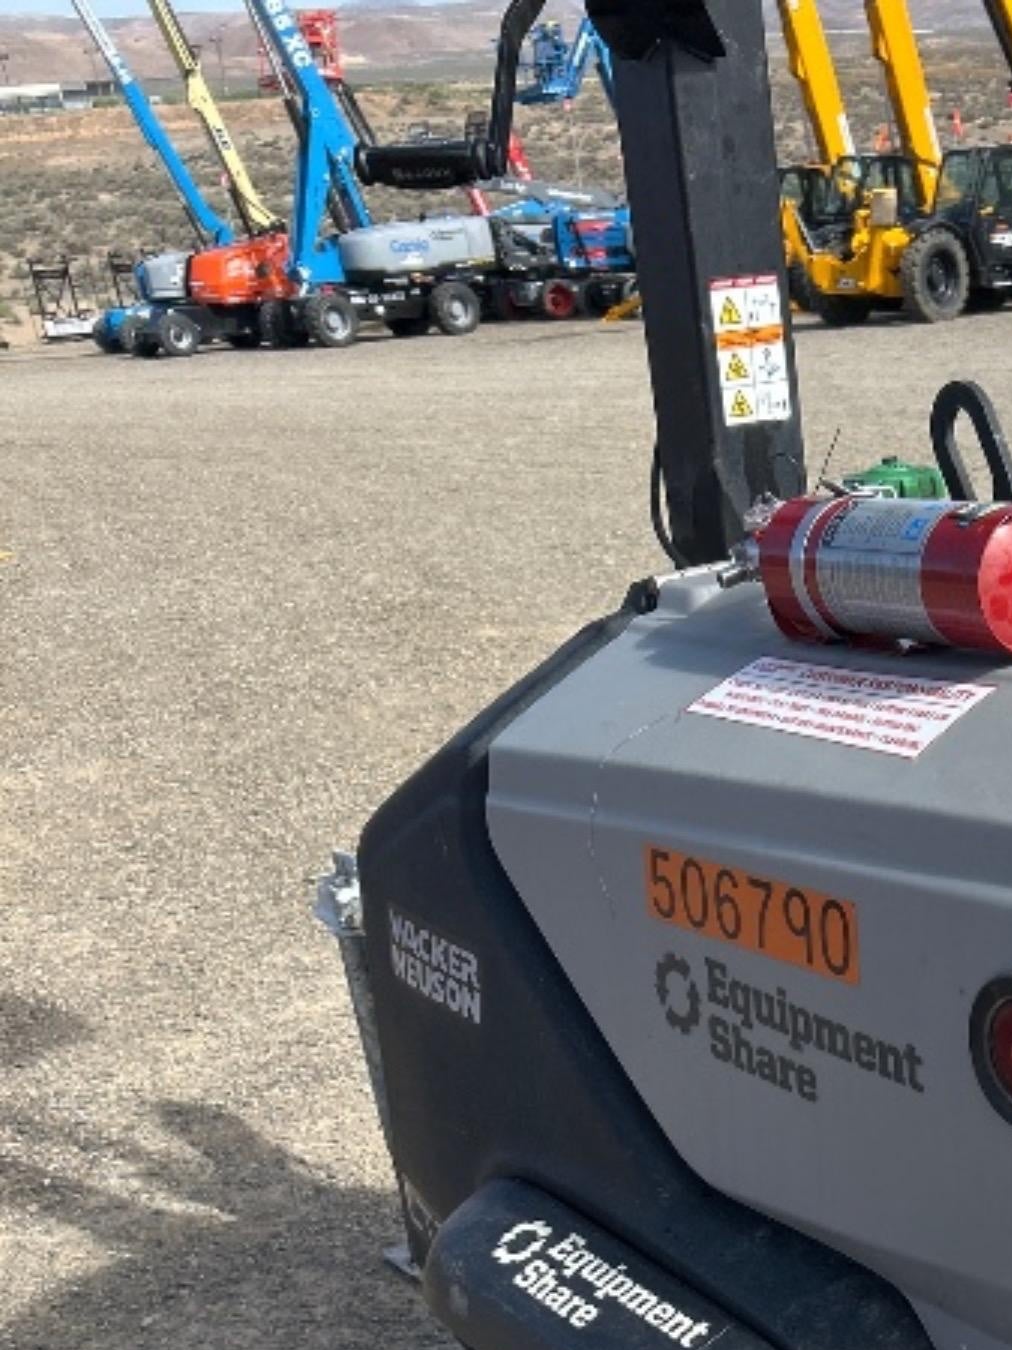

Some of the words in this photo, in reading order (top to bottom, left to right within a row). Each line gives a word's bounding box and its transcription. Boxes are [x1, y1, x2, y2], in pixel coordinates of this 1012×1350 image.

[388, 907, 480, 990] WACKER
[650, 848, 850, 975] 506790
[391, 944, 481, 1025] NEUSON
[704, 956, 925, 1093] Equipment
[708, 1013, 818, 1103] Share
[512, 1259, 599, 1328] Share
[548, 1232, 711, 1348] Equipment
